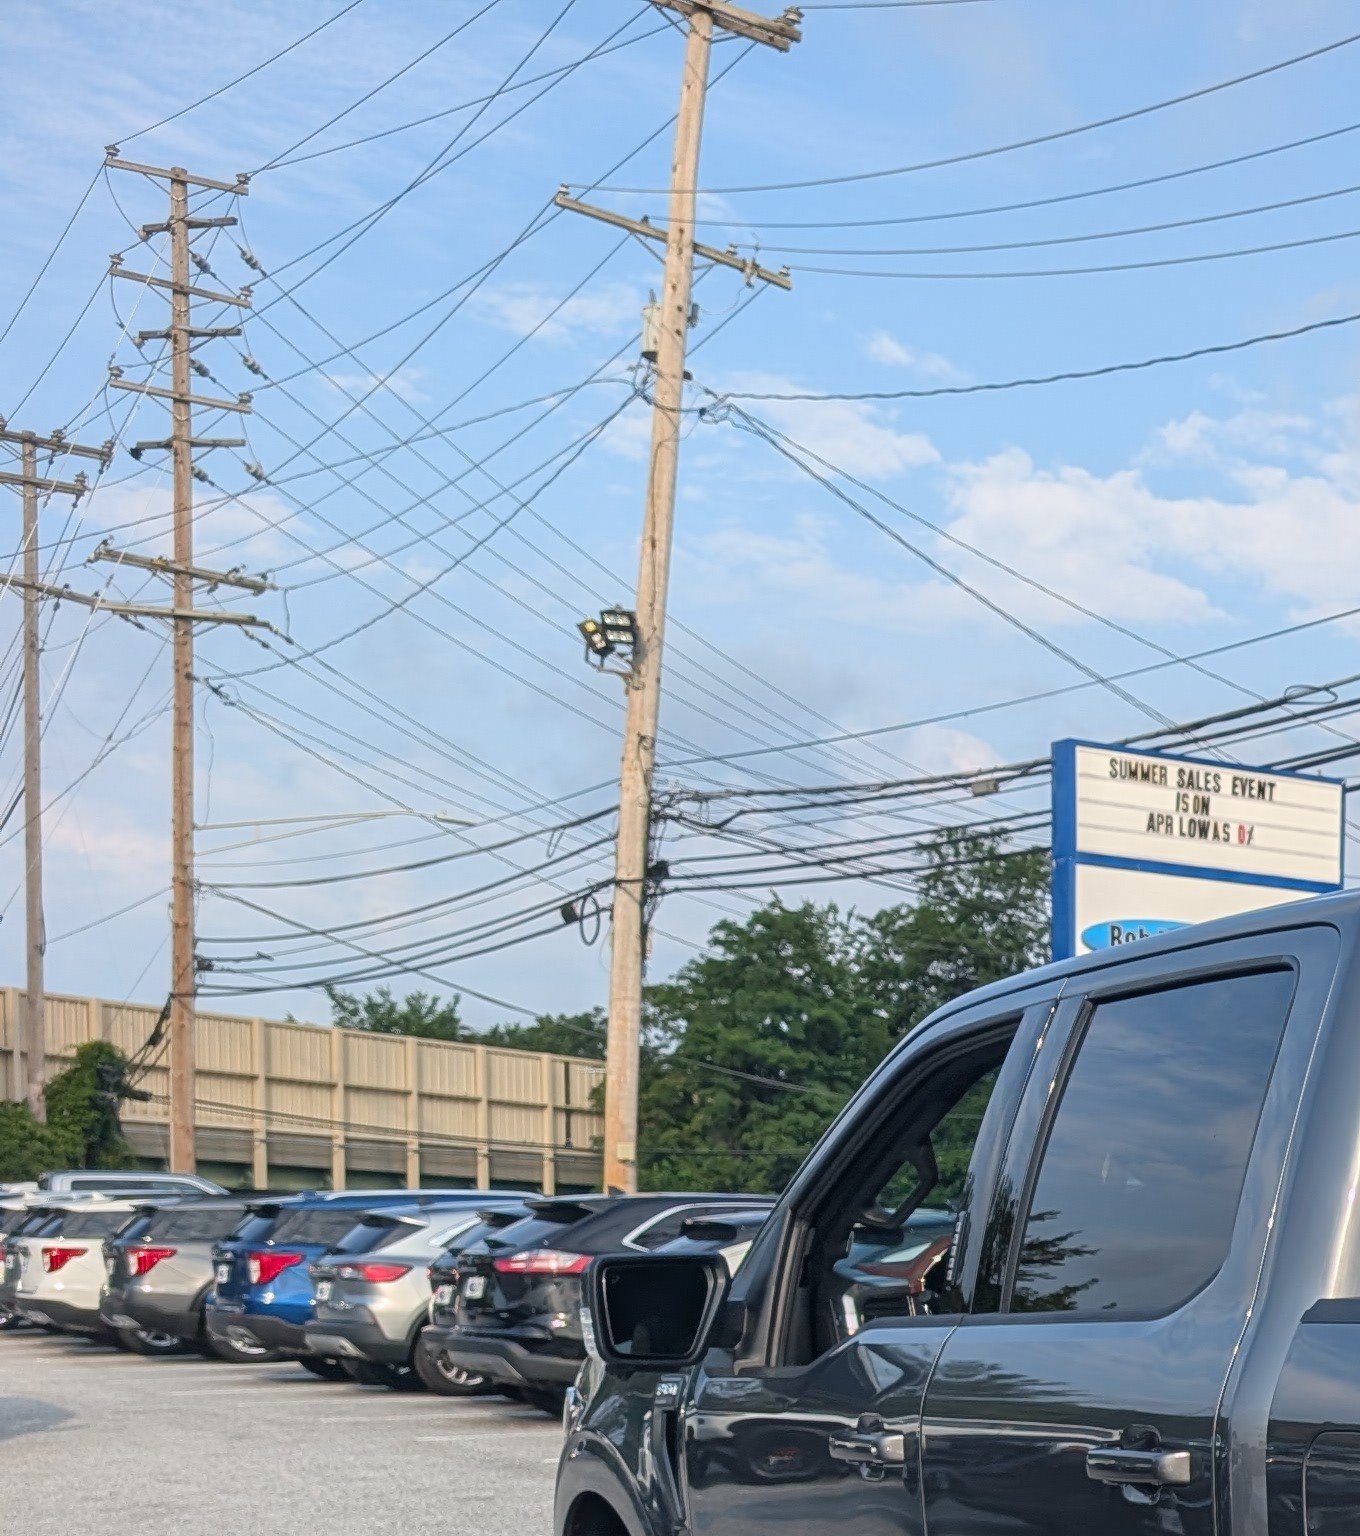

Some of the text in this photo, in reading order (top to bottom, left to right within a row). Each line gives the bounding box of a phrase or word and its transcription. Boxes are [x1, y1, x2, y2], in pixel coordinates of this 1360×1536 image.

[1109, 758, 1276, 801] SUMMER SALES EVENT
[1175, 791, 1211, 816] IS ON
[1146, 811, 1174, 836] APR
